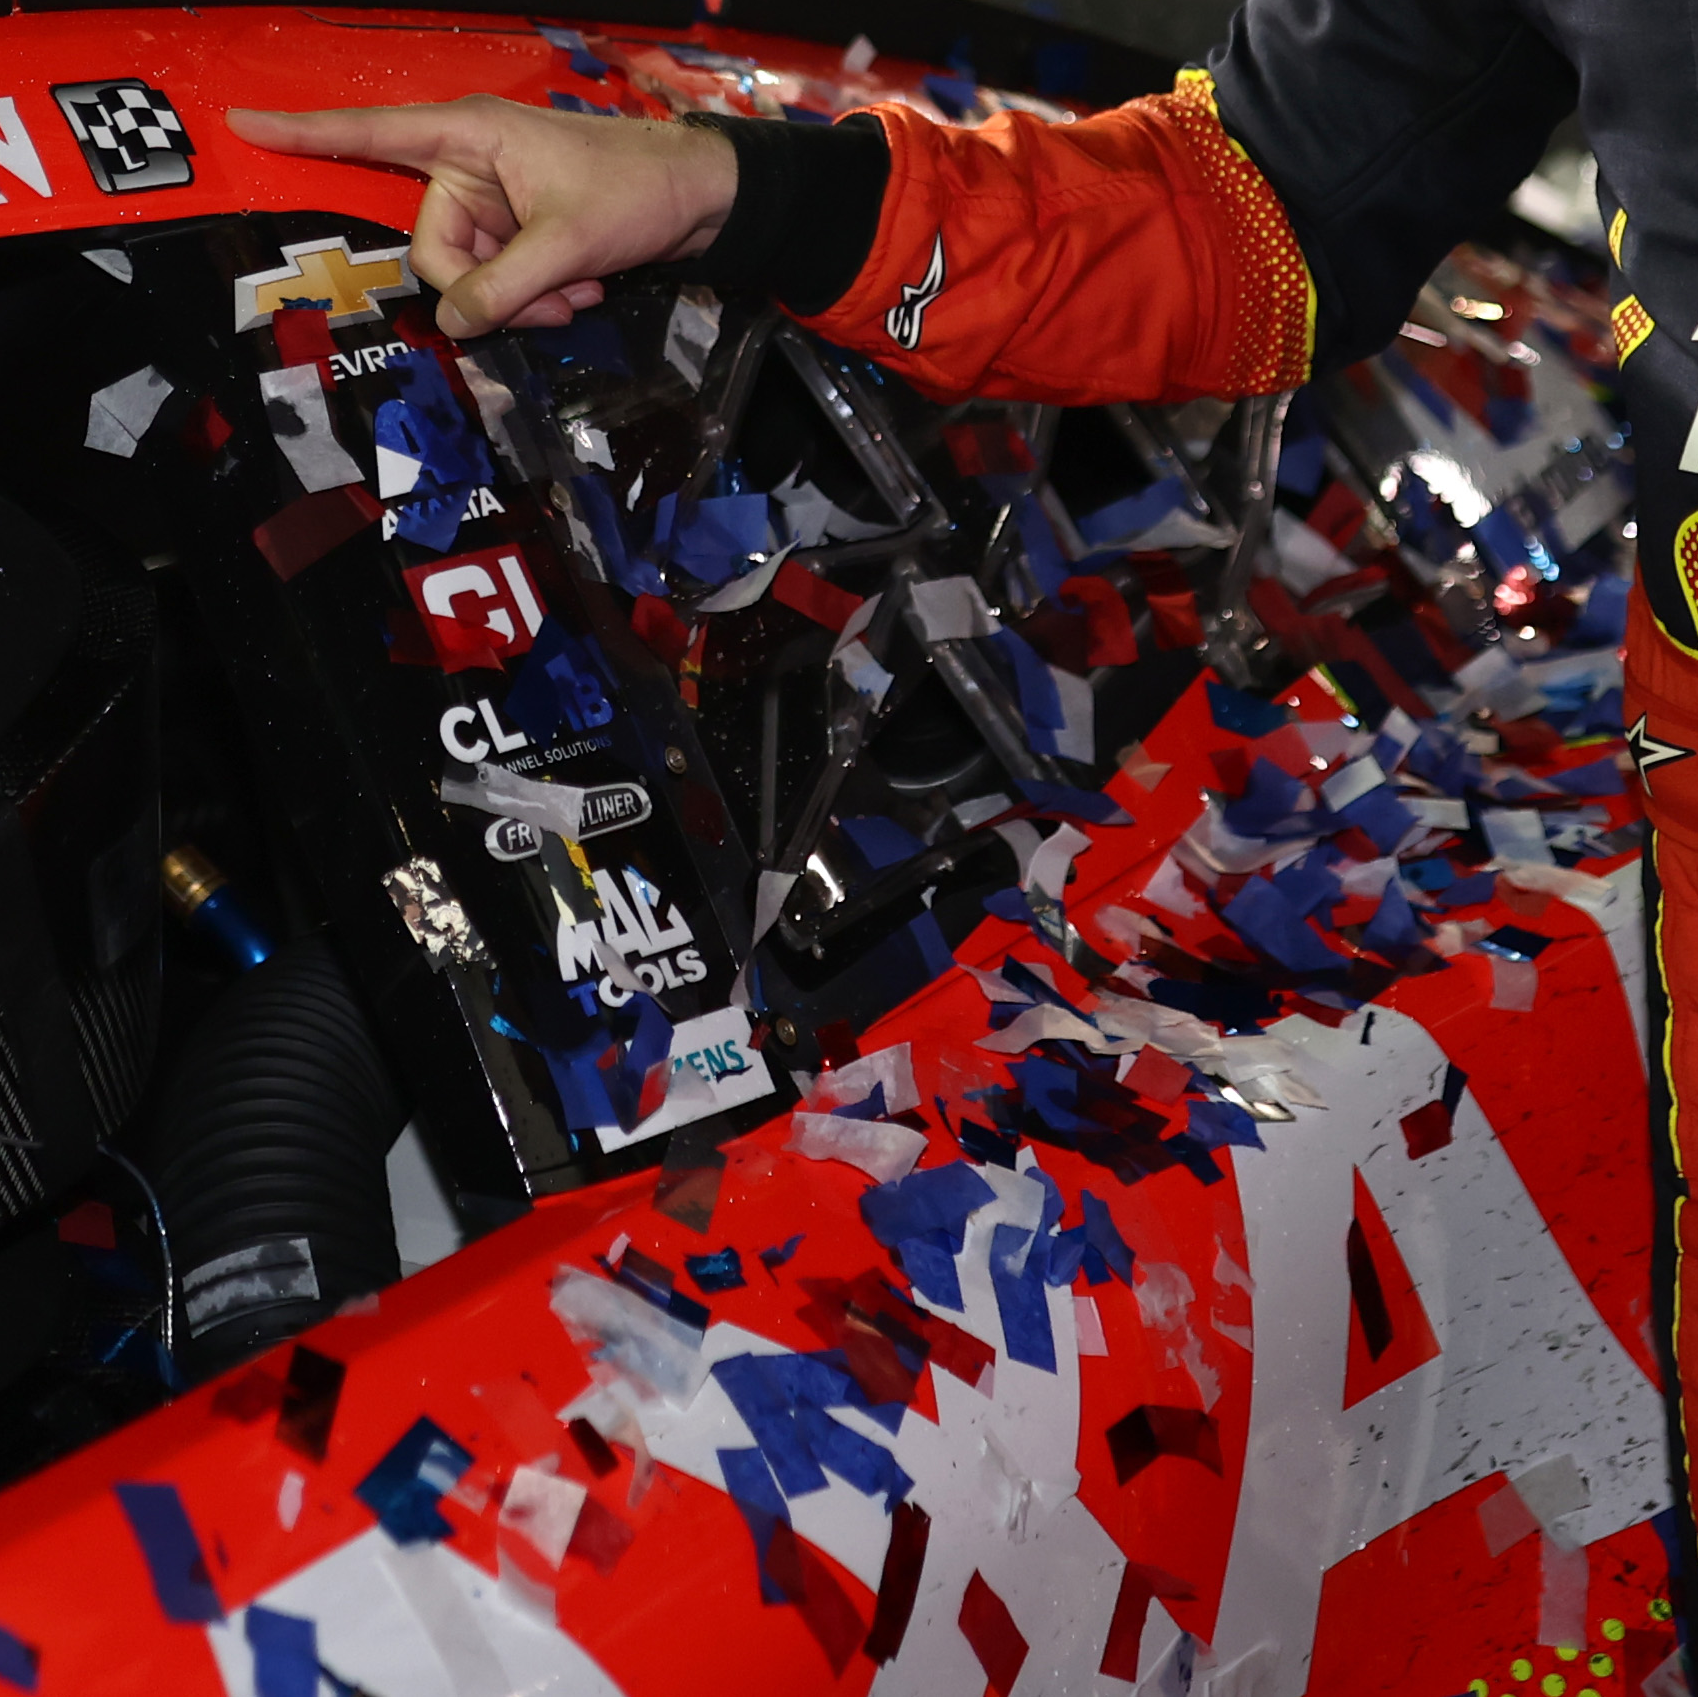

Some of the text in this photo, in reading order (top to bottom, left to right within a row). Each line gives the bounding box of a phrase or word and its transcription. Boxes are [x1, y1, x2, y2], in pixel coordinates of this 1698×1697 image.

[544, 734, 613, 766] SOLUTIONS
[505, 791, 638, 852] FRTLINER
[557, 866, 695, 983] MAC
[566, 947, 708, 1017] TOOLS
